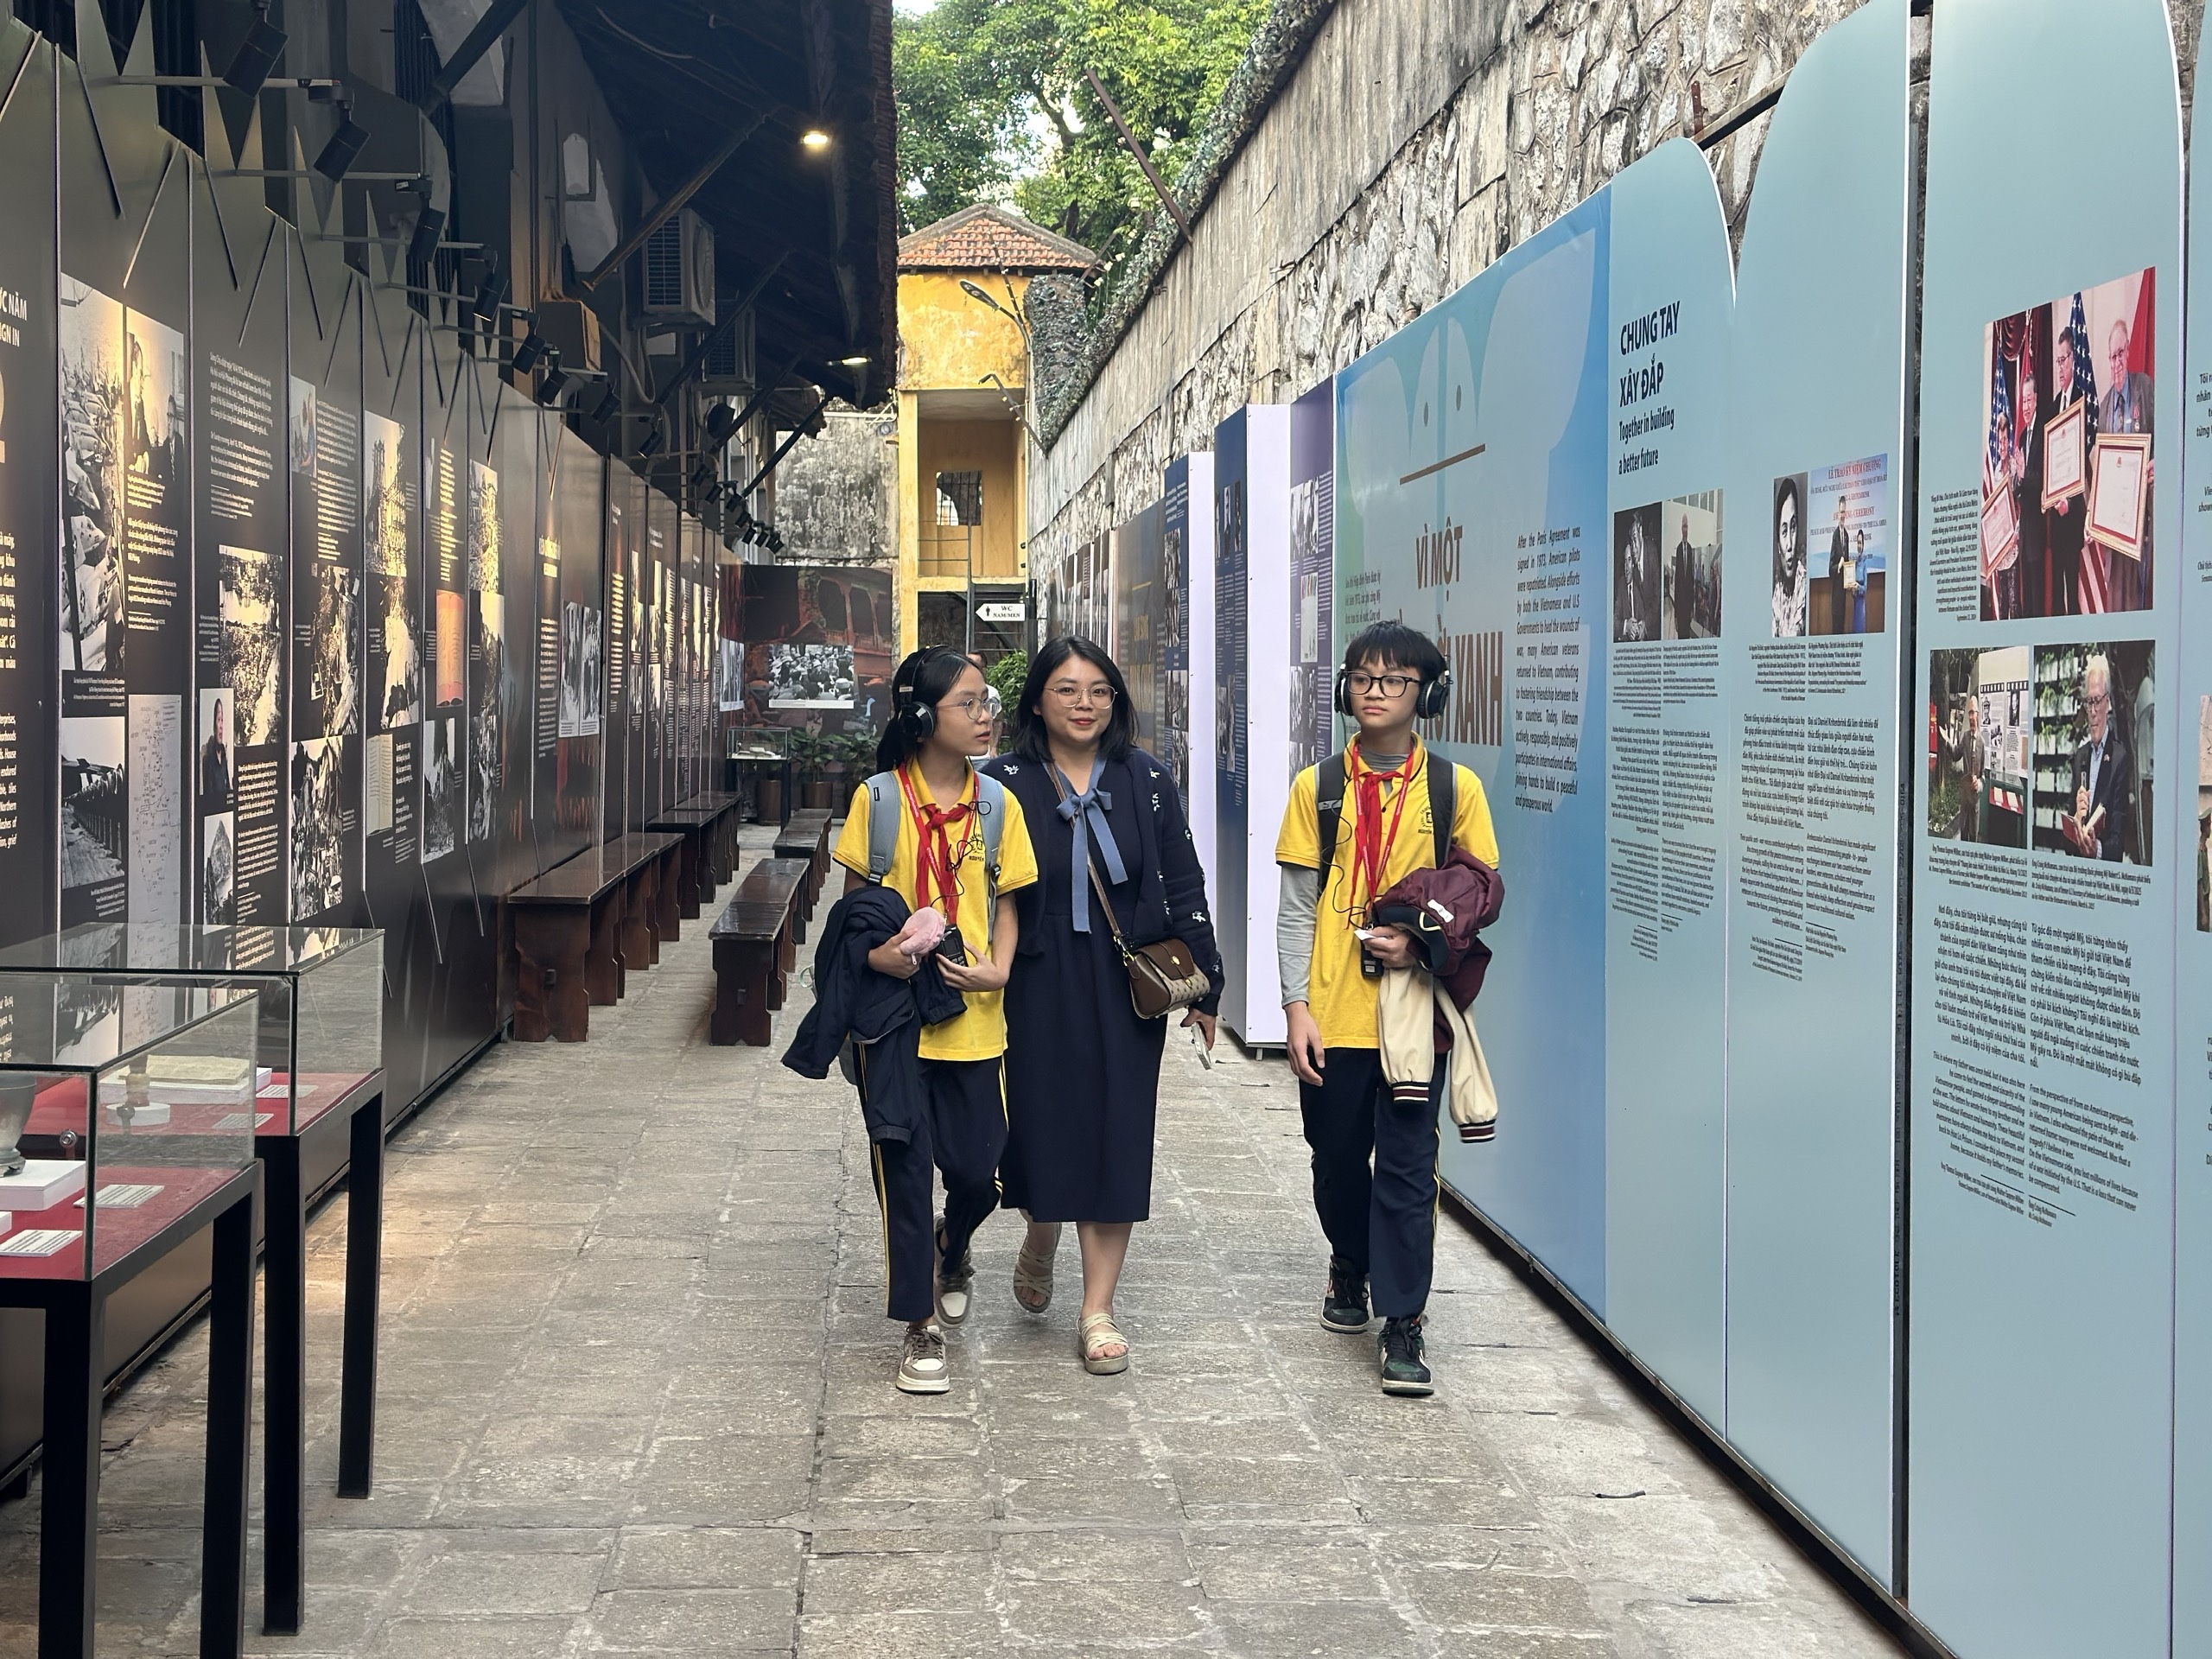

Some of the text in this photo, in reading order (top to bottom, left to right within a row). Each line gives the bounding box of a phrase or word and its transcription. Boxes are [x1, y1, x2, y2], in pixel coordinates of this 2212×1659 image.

[12, 327, 20, 346] IN
[1620, 301, 1680, 355] CHUNG TAY
[1619, 353, 1663, 408] XÂY ĐẮP
[1619, 405, 1674, 444] Together in building
[1618, 448, 1658, 474] a better future
[1415, 523, 1428, 589] VÌ
[1431, 517, 1463, 601] MỘT
[1454, 632, 1503, 747] XANH
